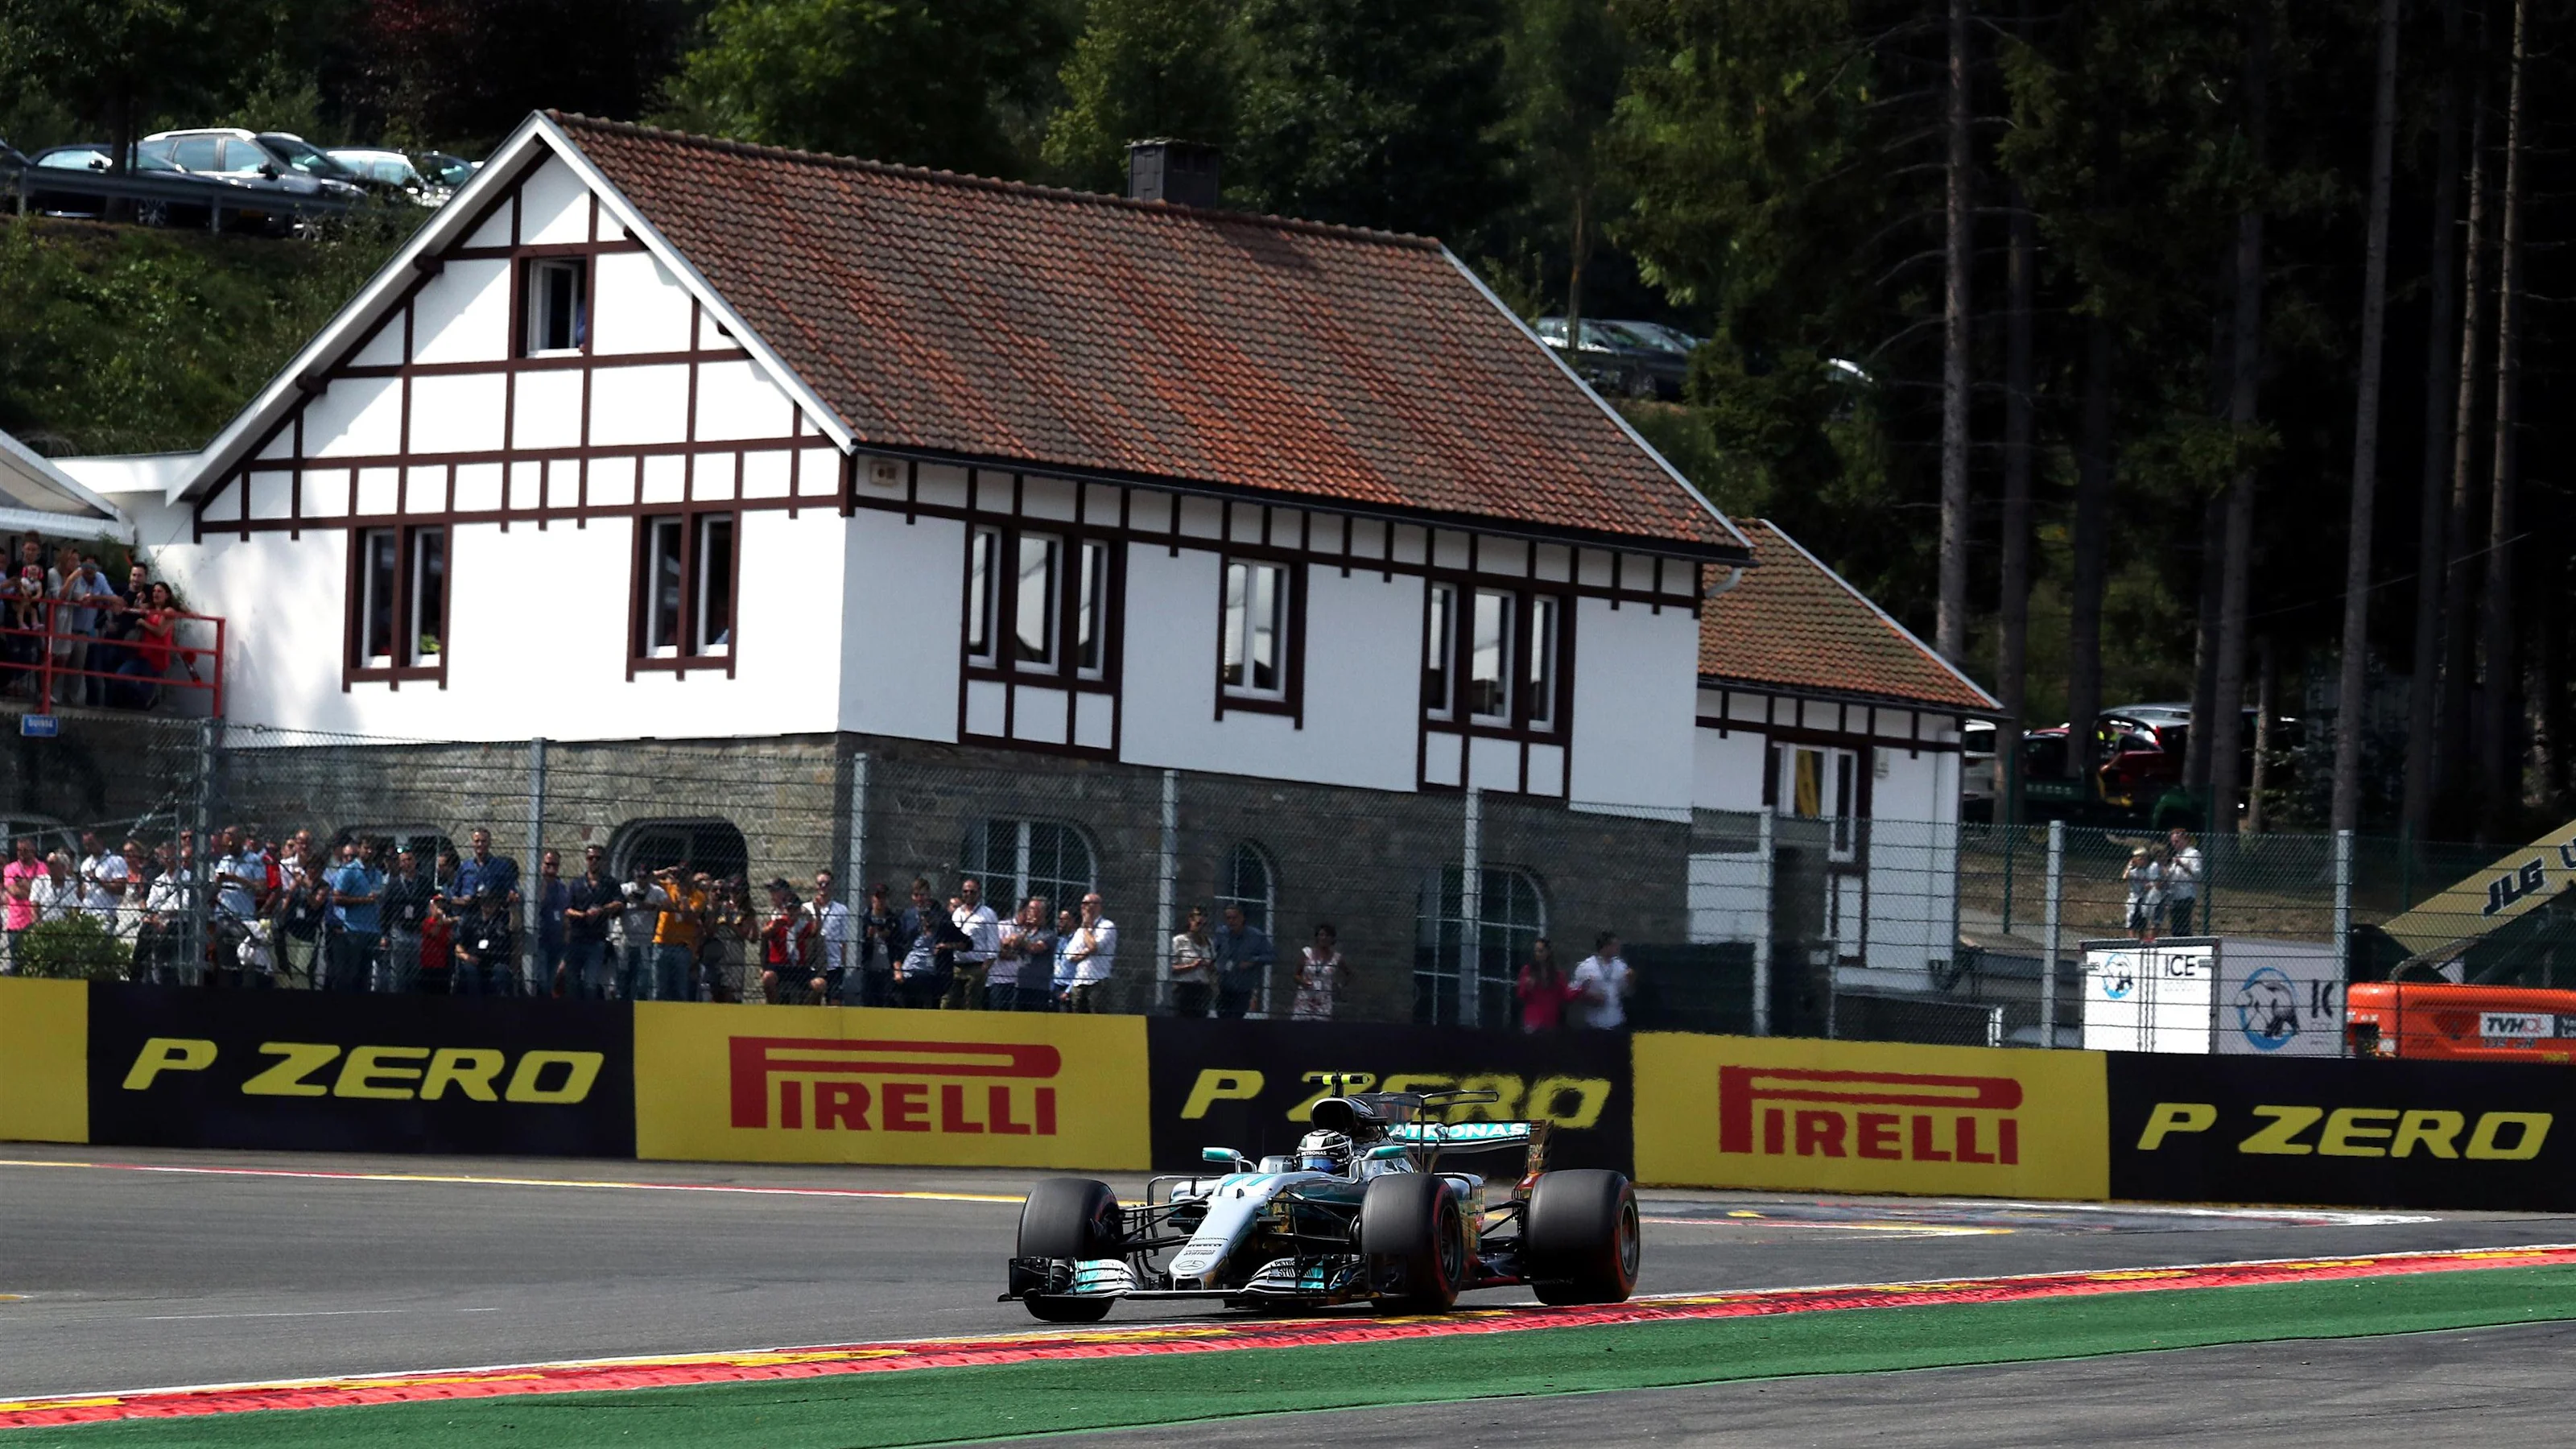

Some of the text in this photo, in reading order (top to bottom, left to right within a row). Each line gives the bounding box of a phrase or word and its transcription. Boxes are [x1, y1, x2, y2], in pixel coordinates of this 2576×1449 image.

[2483, 857, 2544, 918] JLG
[2165, 955, 2196, 977] ICE
[122, 1038, 604, 1104] P ZERO
[729, 1036, 1061, 1135] PIRELLI
[1181, 1068, 1611, 1129] P ZERO
[1719, 1066, 2023, 1165] PIRELLI
[2137, 1103, 2553, 1160] P ZERO
